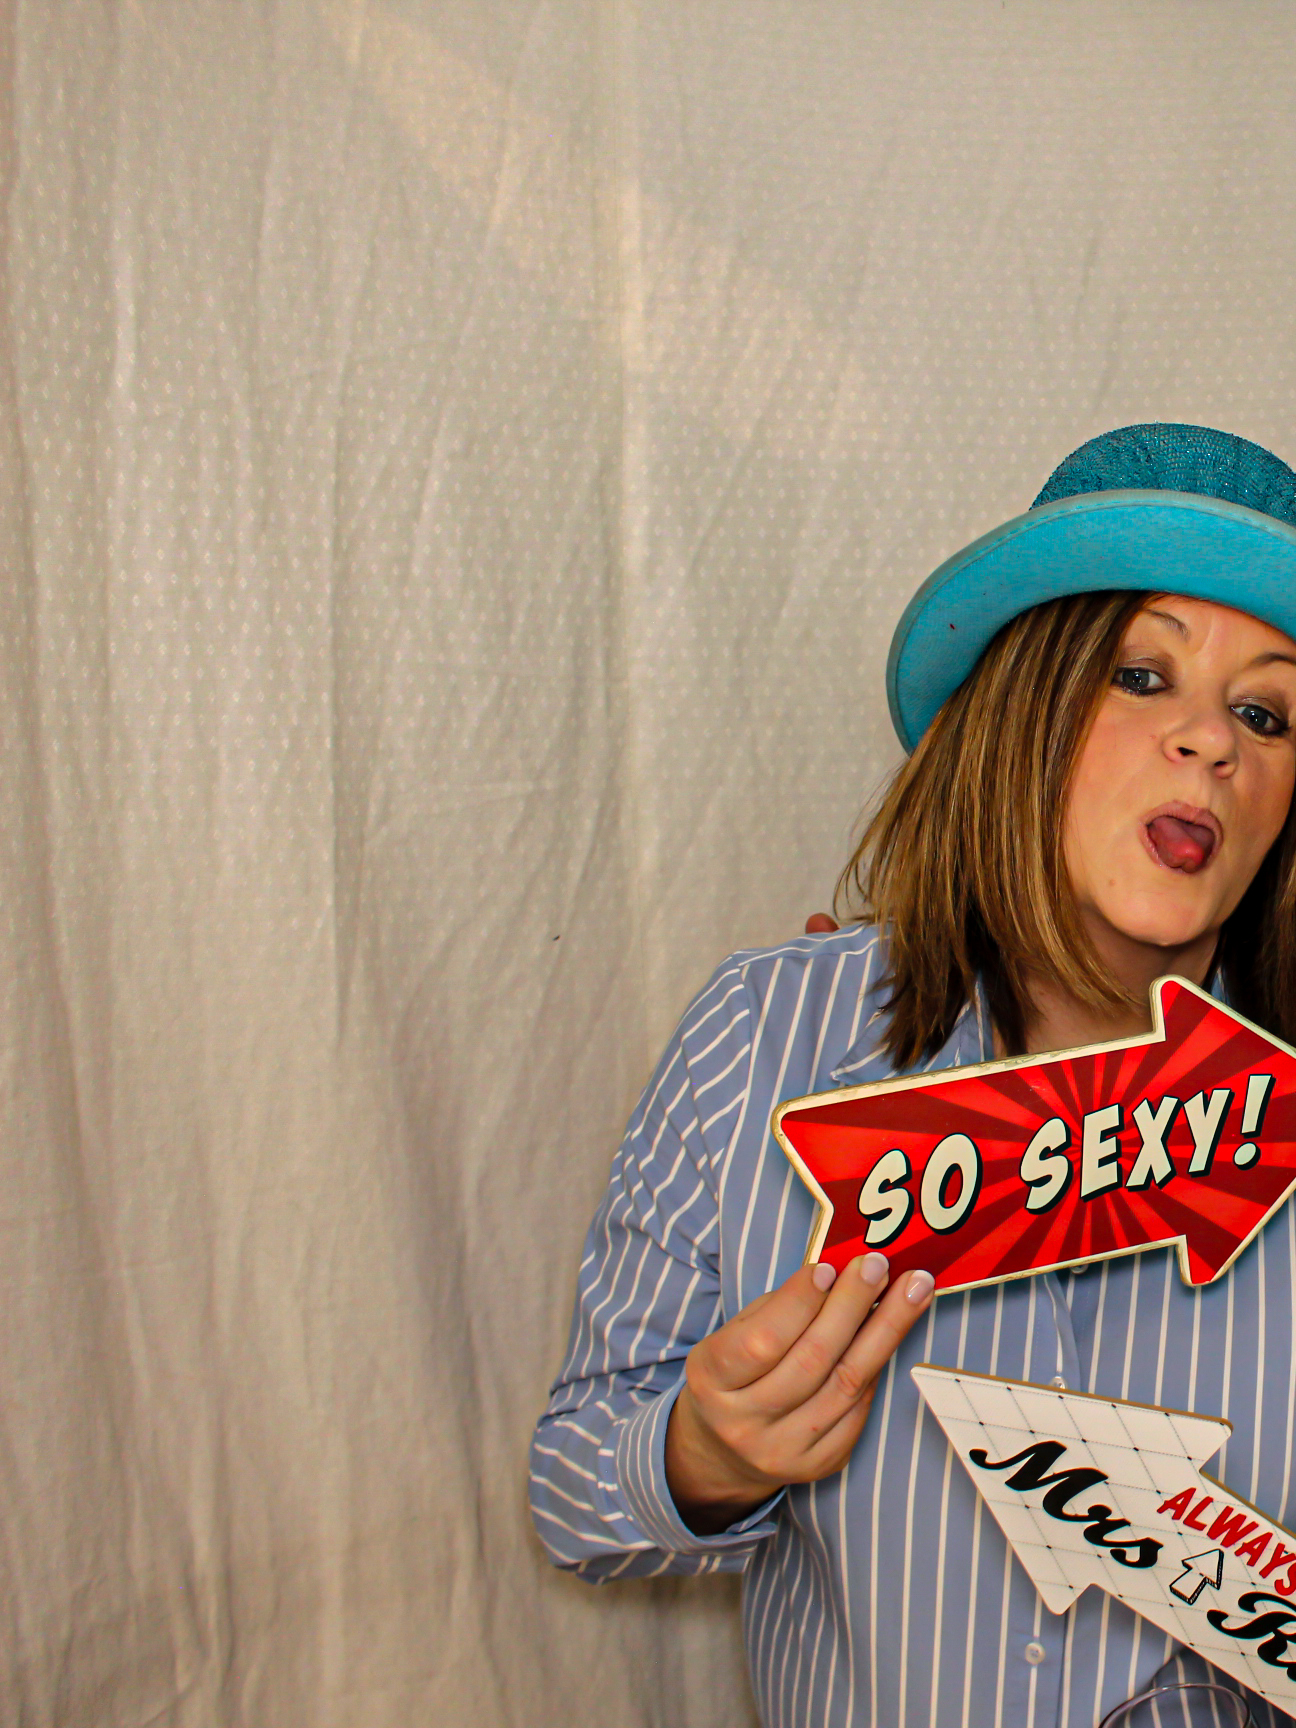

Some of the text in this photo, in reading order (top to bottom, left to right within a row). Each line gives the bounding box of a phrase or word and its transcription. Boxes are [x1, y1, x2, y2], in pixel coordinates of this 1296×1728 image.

[858, 1074, 1274, 1249] SO SEXY!
[968, 1440, 1164, 1569] Mrs
